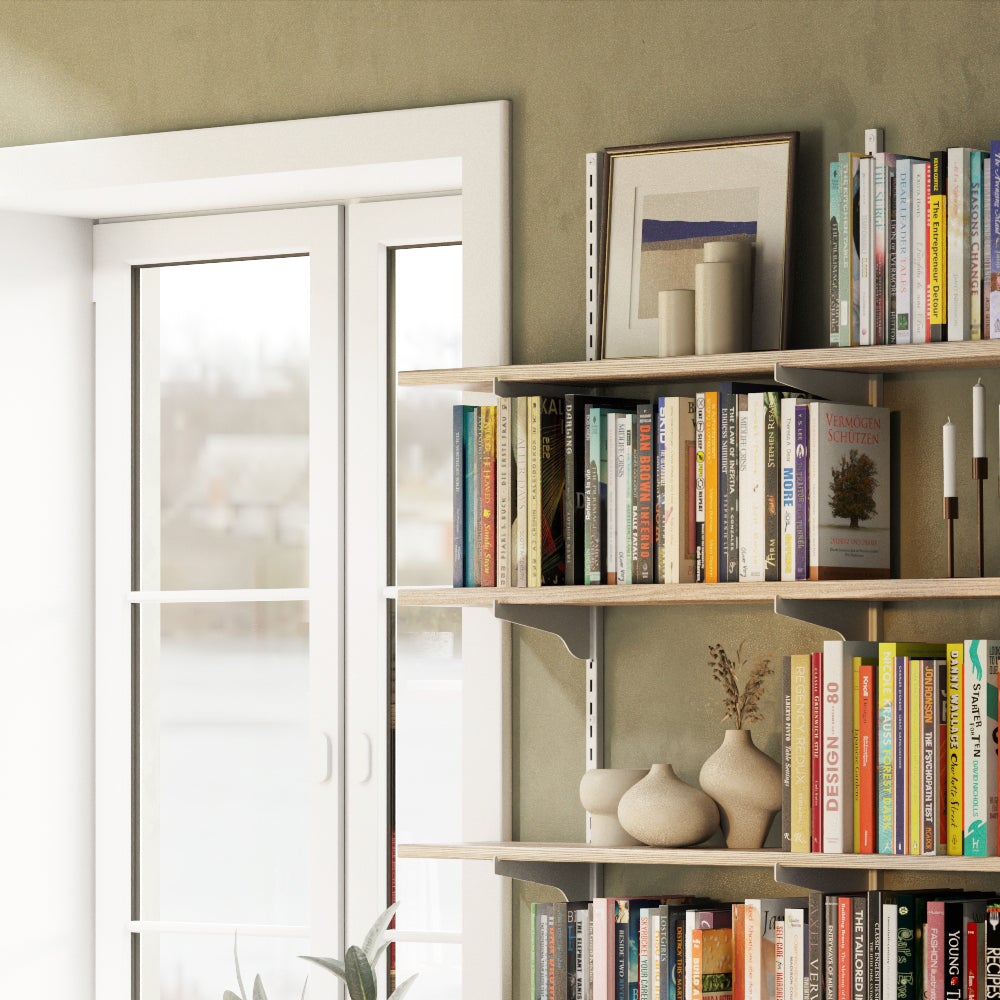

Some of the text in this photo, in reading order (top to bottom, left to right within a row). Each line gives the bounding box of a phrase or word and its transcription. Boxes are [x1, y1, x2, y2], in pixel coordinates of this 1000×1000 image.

[899, 173, 907, 294] DEAR LEADER TALES
[971, 182, 980, 296] SEASONS CHANGE
[930, 201, 940, 318] The Entrepreneur Detour
[826, 413, 880, 430] VERMÖGEN
[828, 428, 879, 445] SCHÜTZEN
[730, 447, 735, 457] OF
[640, 425, 651, 558] DAN BROWN INFERNO
[784, 468, 793, 506] MORE
[924, 666, 934, 682] JON
[924, 683, 934, 723] RONSON
[796, 666, 804, 784] REGENCY REDUX
[827, 682, 838, 811] DESIGN 80
[882, 652, 892, 830] NICOLE KRAUSS FOREST DARK
[924, 732, 934, 748] THE
[950, 650, 959, 828] DANNY WALLACE Charlotte Street
[924, 750, 934, 802] PSYCHOPATH
[924, 803, 934, 822] TEST
[855, 910, 864, 933] THE
[692, 958, 700, 984] BUILD
[828, 966, 834, 976] OF
[855, 934, 864, 992] TAILORED
[947, 930, 960, 976] YOUNG
